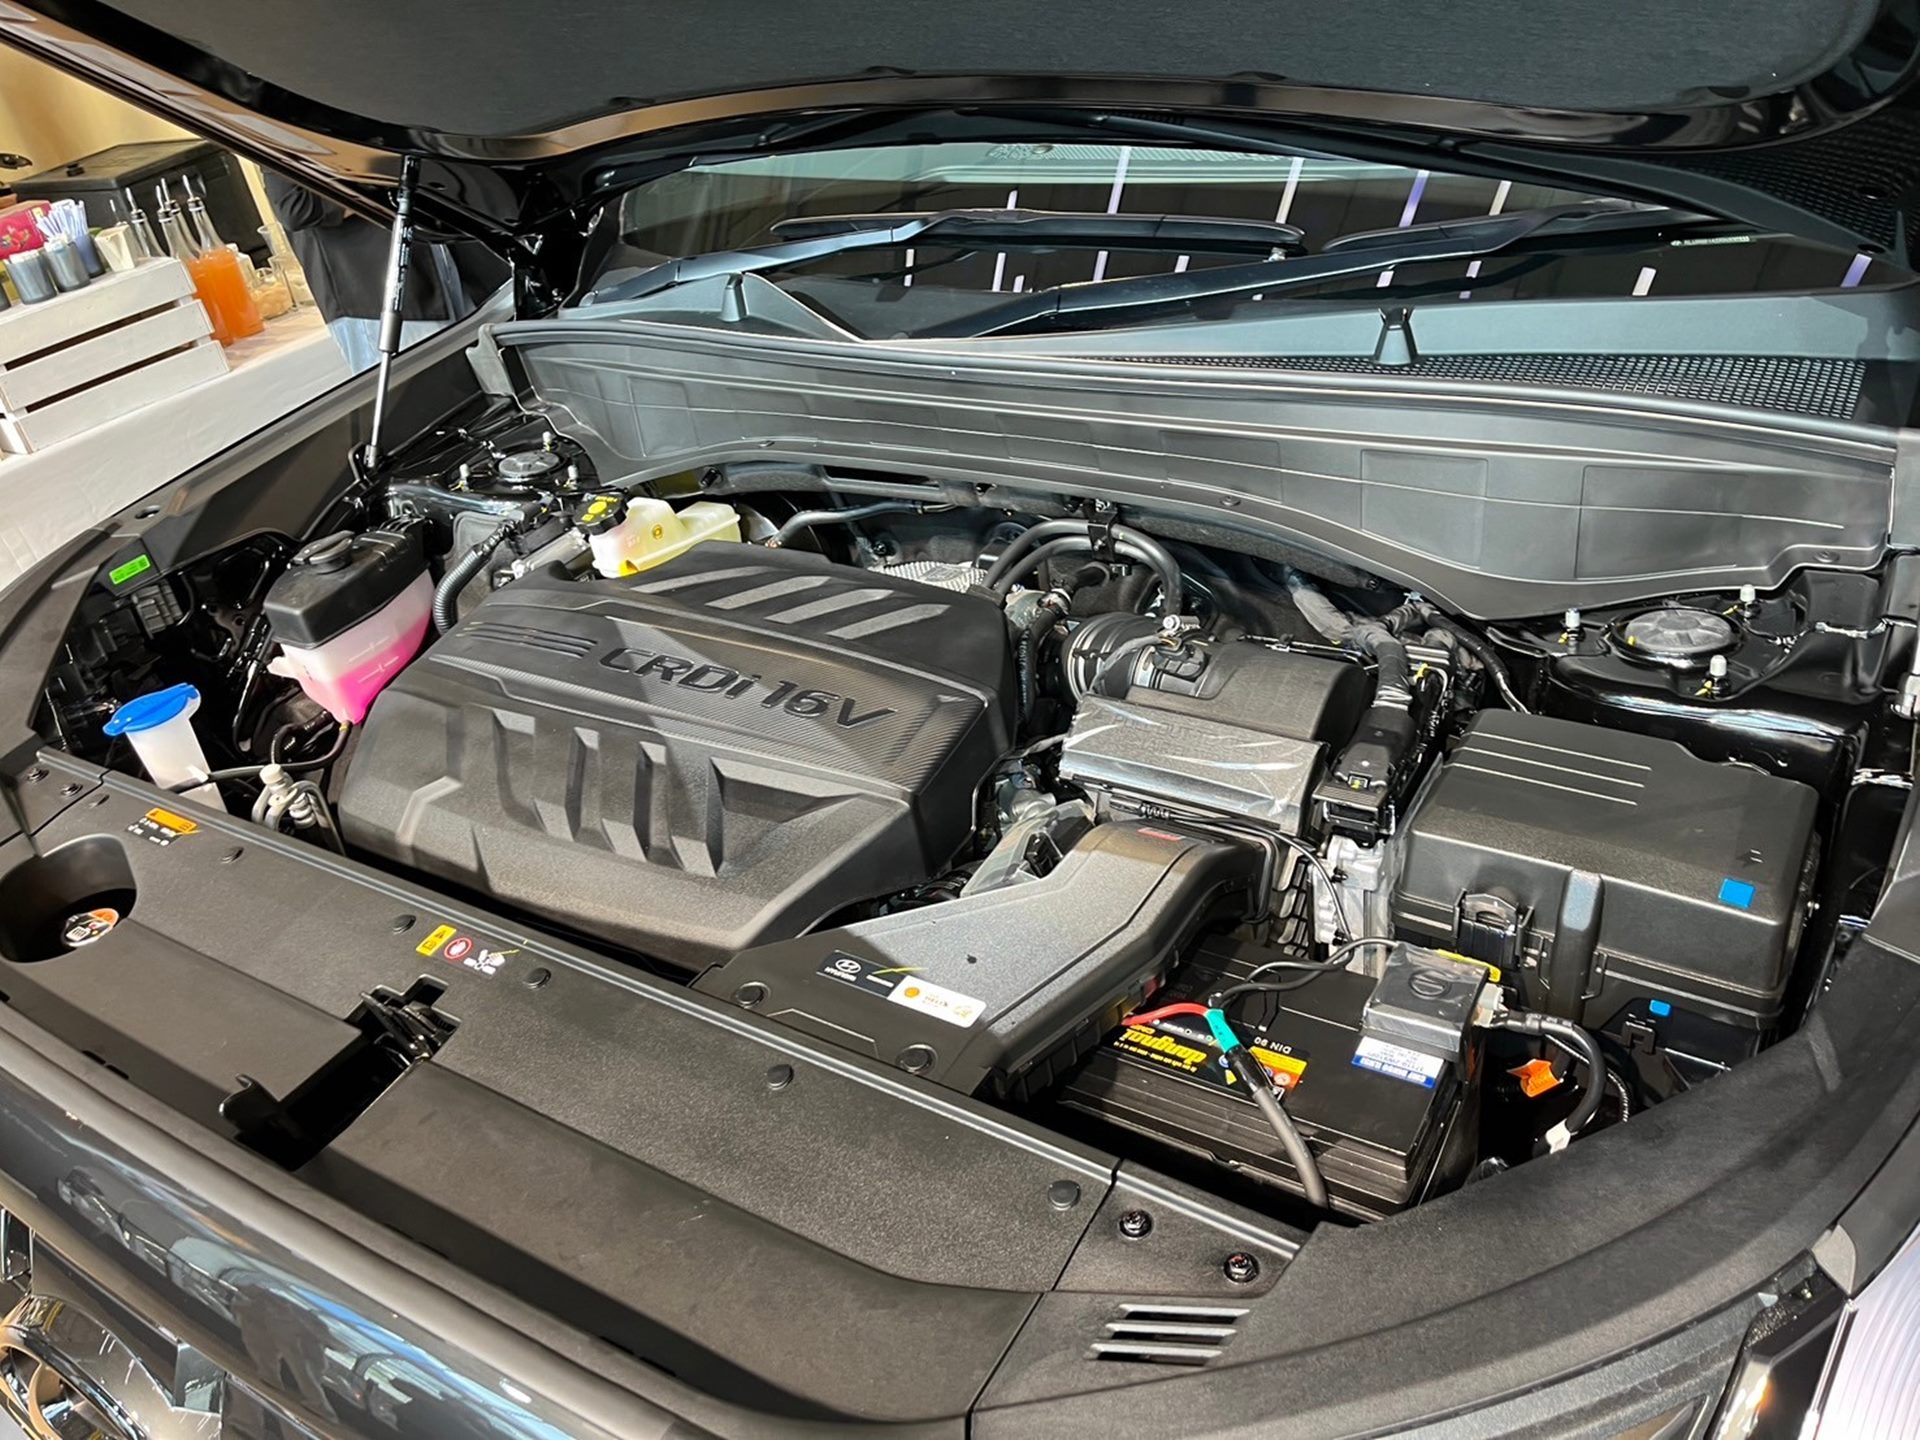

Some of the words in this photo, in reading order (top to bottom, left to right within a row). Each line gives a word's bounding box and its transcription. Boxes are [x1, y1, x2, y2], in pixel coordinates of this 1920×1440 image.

[599, 647, 762, 700] CRDi
[761, 679, 898, 728] 16V
[1269, 1041, 1292, 1055] DIN
